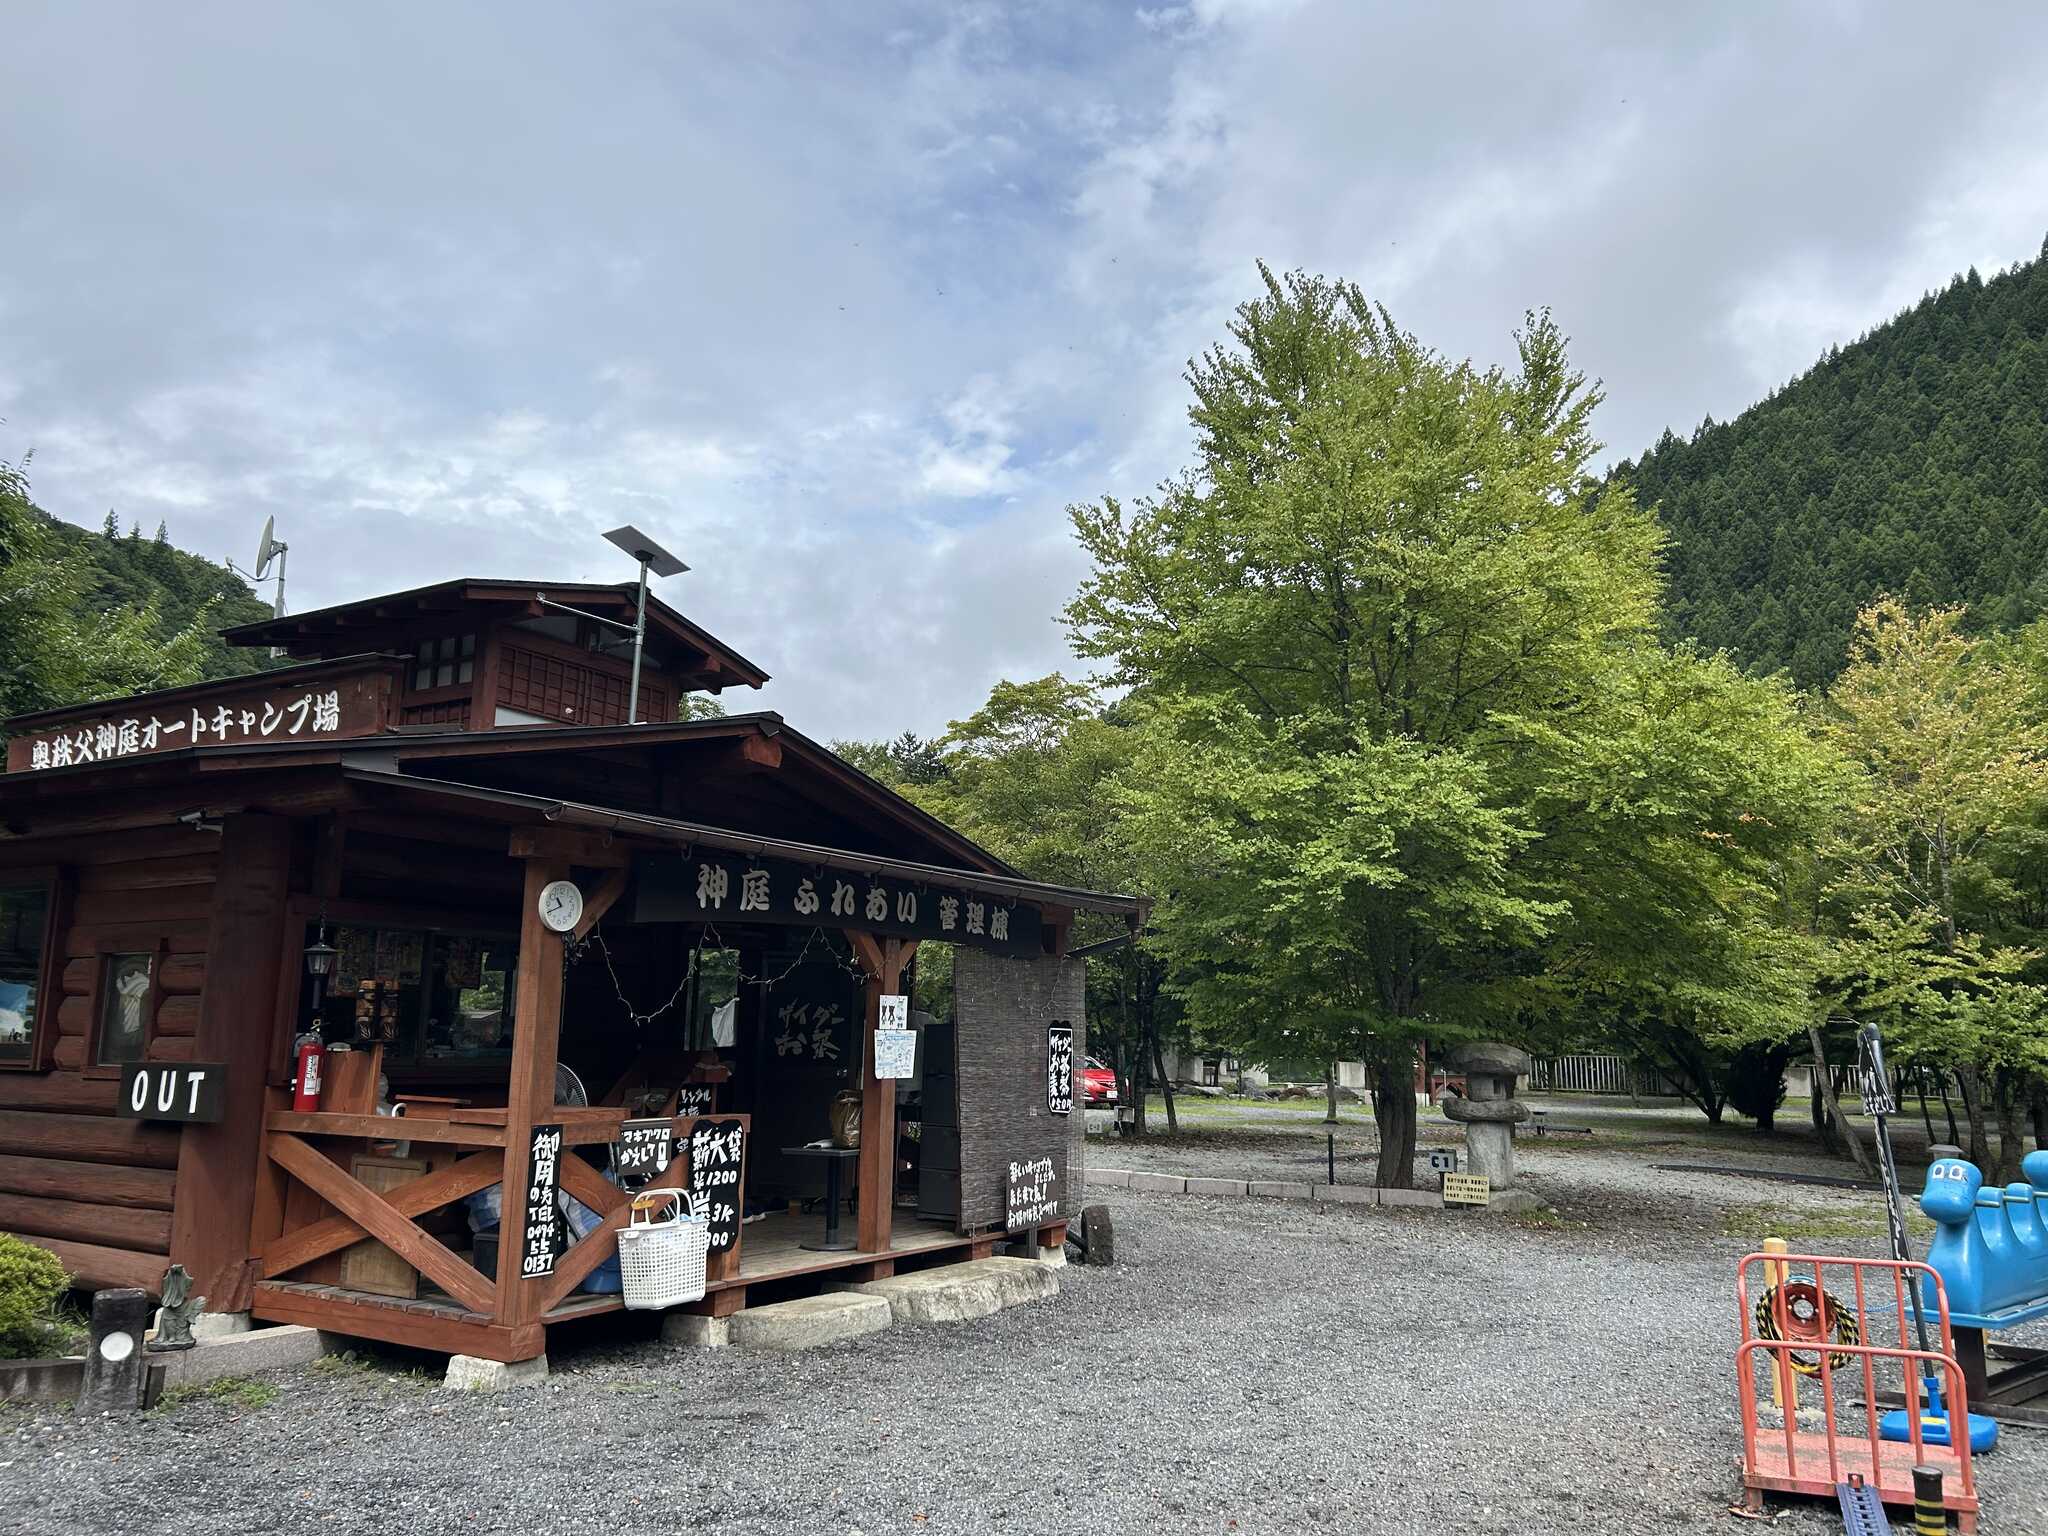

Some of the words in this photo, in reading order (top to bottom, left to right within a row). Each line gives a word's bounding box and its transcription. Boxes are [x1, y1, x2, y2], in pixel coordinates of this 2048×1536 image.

[31, 690, 340, 769] 奥秩父神庭オートキャンプ場
[696, 864, 771, 912] 神庭
[794, 879, 917, 923] ふれあい
[939, 896, 1009, 940] 管理棟
[131, 1070, 205, 1113] OUT
[529, 1206, 554, 1222] TEL
[527, 1222, 555, 1239] 0494
[530, 1239, 550, 1255] 55
[523, 1254, 554, 1273] 0137
